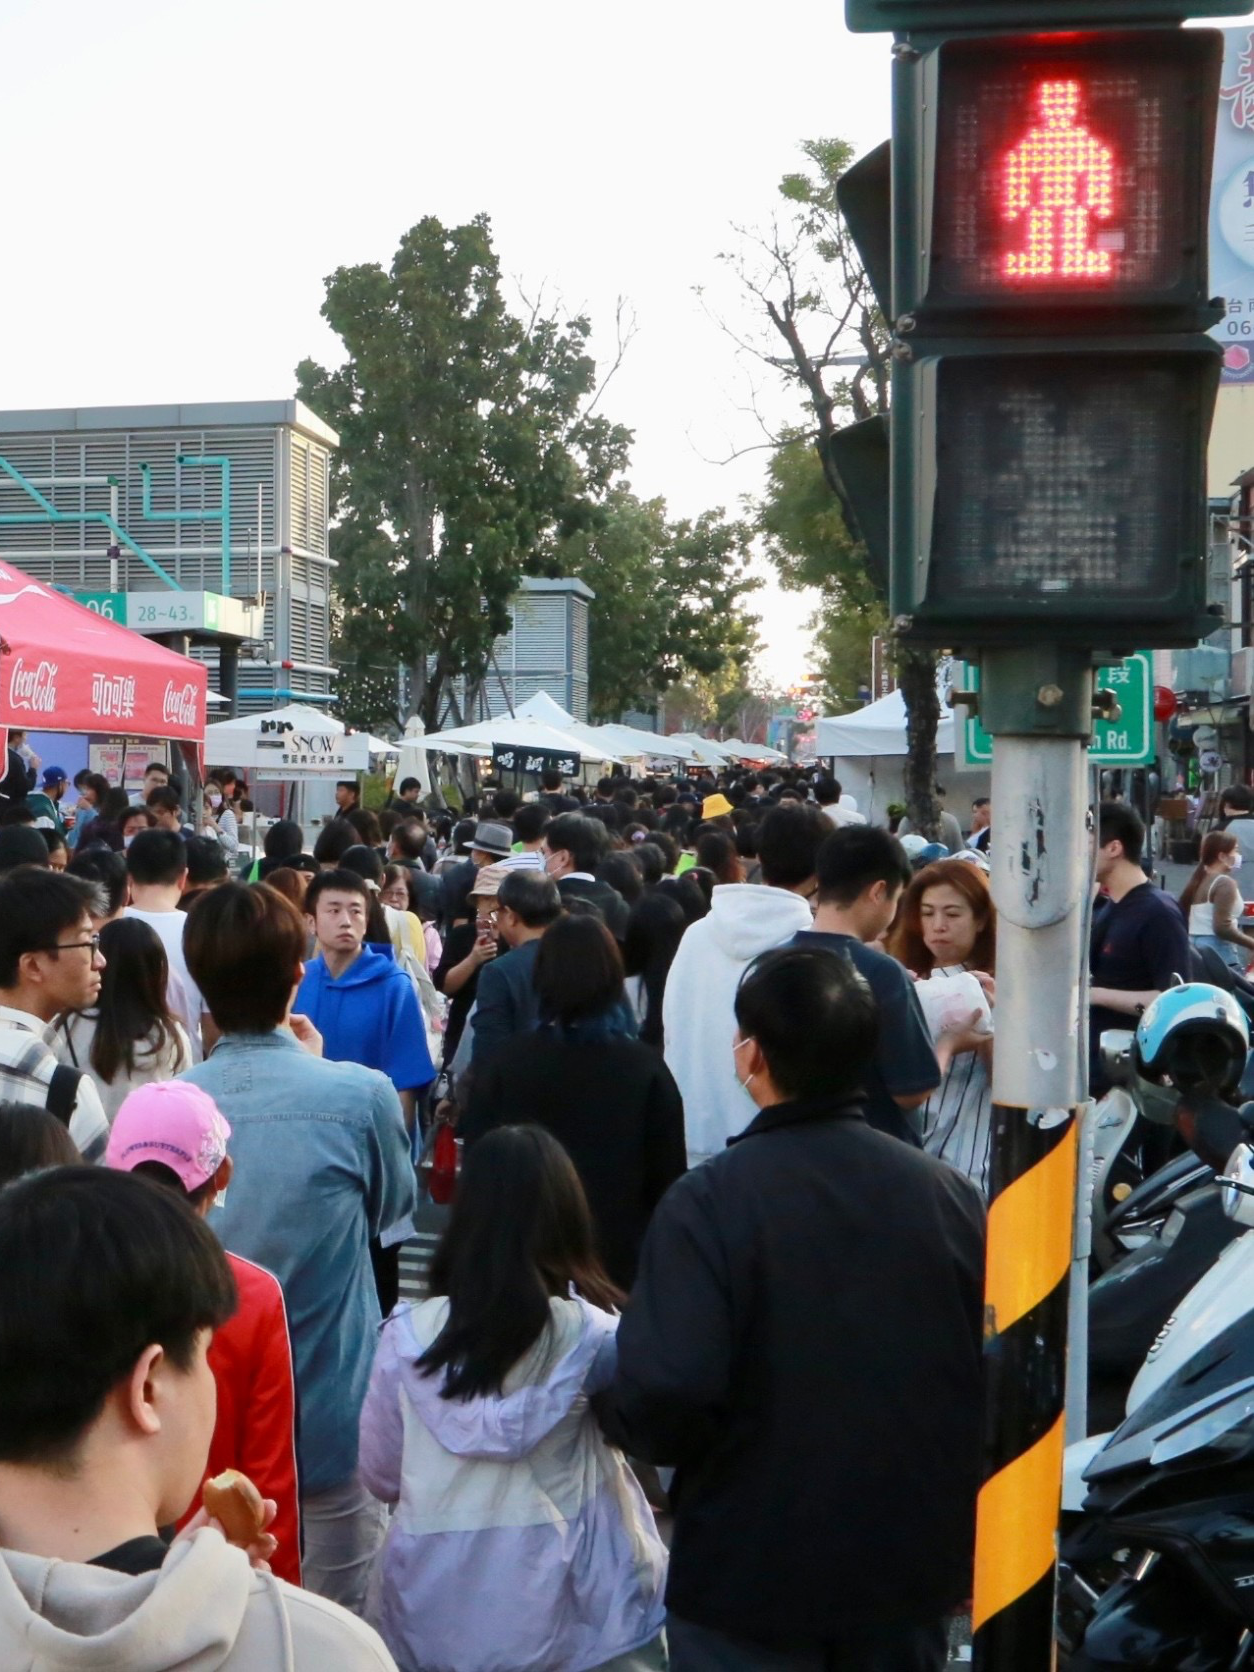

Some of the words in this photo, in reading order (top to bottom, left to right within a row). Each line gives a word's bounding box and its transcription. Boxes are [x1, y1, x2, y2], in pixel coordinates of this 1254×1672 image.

[137, 606, 188, 622] 28~43
[9, 657, 58, 713] Coca-Cola
[92, 673, 136, 718] 可口可樂
[162, 680, 199, 726] Coca-Cola
[291, 735, 336, 753] SNOW
[1107, 730, 1132, 750] Rd.
